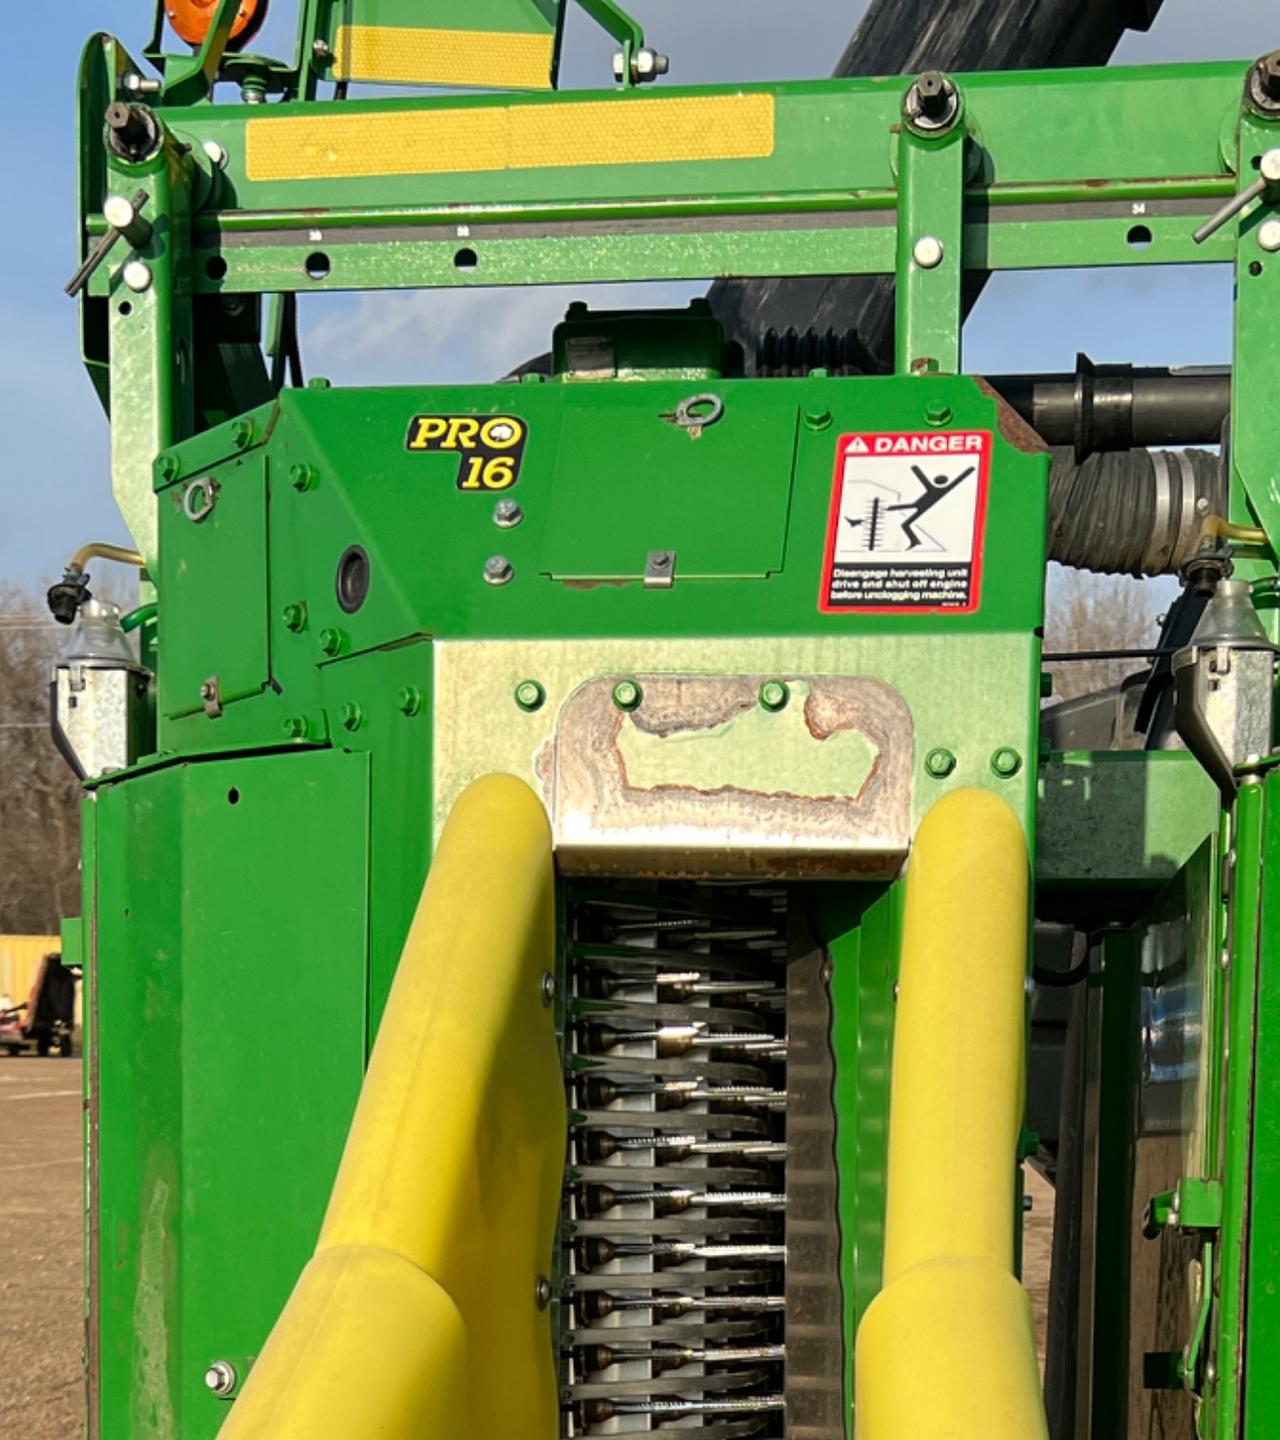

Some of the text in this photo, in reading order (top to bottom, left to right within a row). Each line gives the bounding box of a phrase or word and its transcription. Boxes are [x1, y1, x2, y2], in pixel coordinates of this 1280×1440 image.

[409, 417, 523, 449] PRO
[875, 435, 983, 452] DANGER
[462, 456, 515, 489] 16
[834, 568, 968, 580] Disengage harvesting unit
[832, 580, 968, 590] drive and shut off engine
[831, 590, 968, 601] before unclogging machine.
